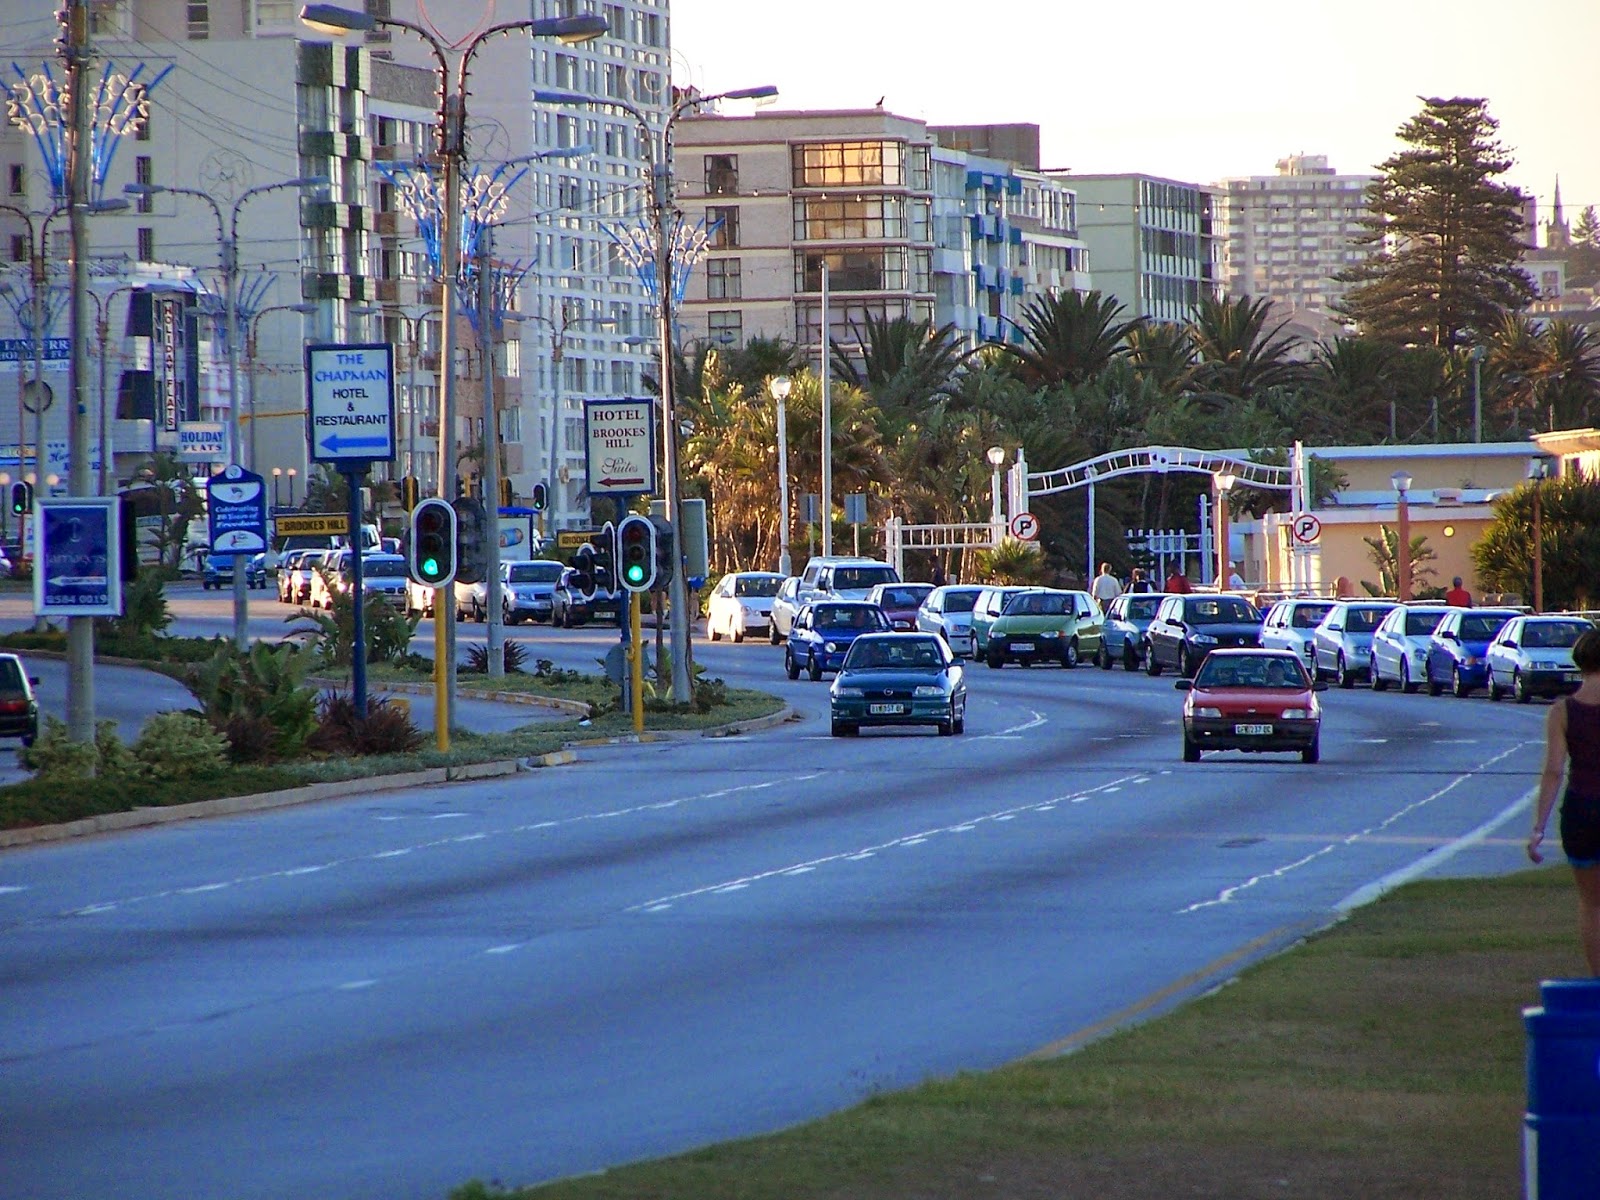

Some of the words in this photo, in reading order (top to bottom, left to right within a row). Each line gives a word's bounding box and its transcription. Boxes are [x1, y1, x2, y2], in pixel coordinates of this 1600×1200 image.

[335, 353, 365, 365] THE
[314, 369, 387, 382] CHAPMAN
[332, 388, 369, 399] HOTEL
[166, 379, 175, 426] FLATS
[346, 401, 355, 412] &
[315, 414, 388, 426] RESTAURANT
[593, 409, 645, 421] HOTEL
[181, 431, 224, 443] HOLIDAY
[592, 427, 646, 438] BROOKES
[605, 439, 634, 448] HILL
[601, 457, 639, 475] Suites
[284, 521, 325, 531] BROOKES
[327, 519, 346, 530] HILL
